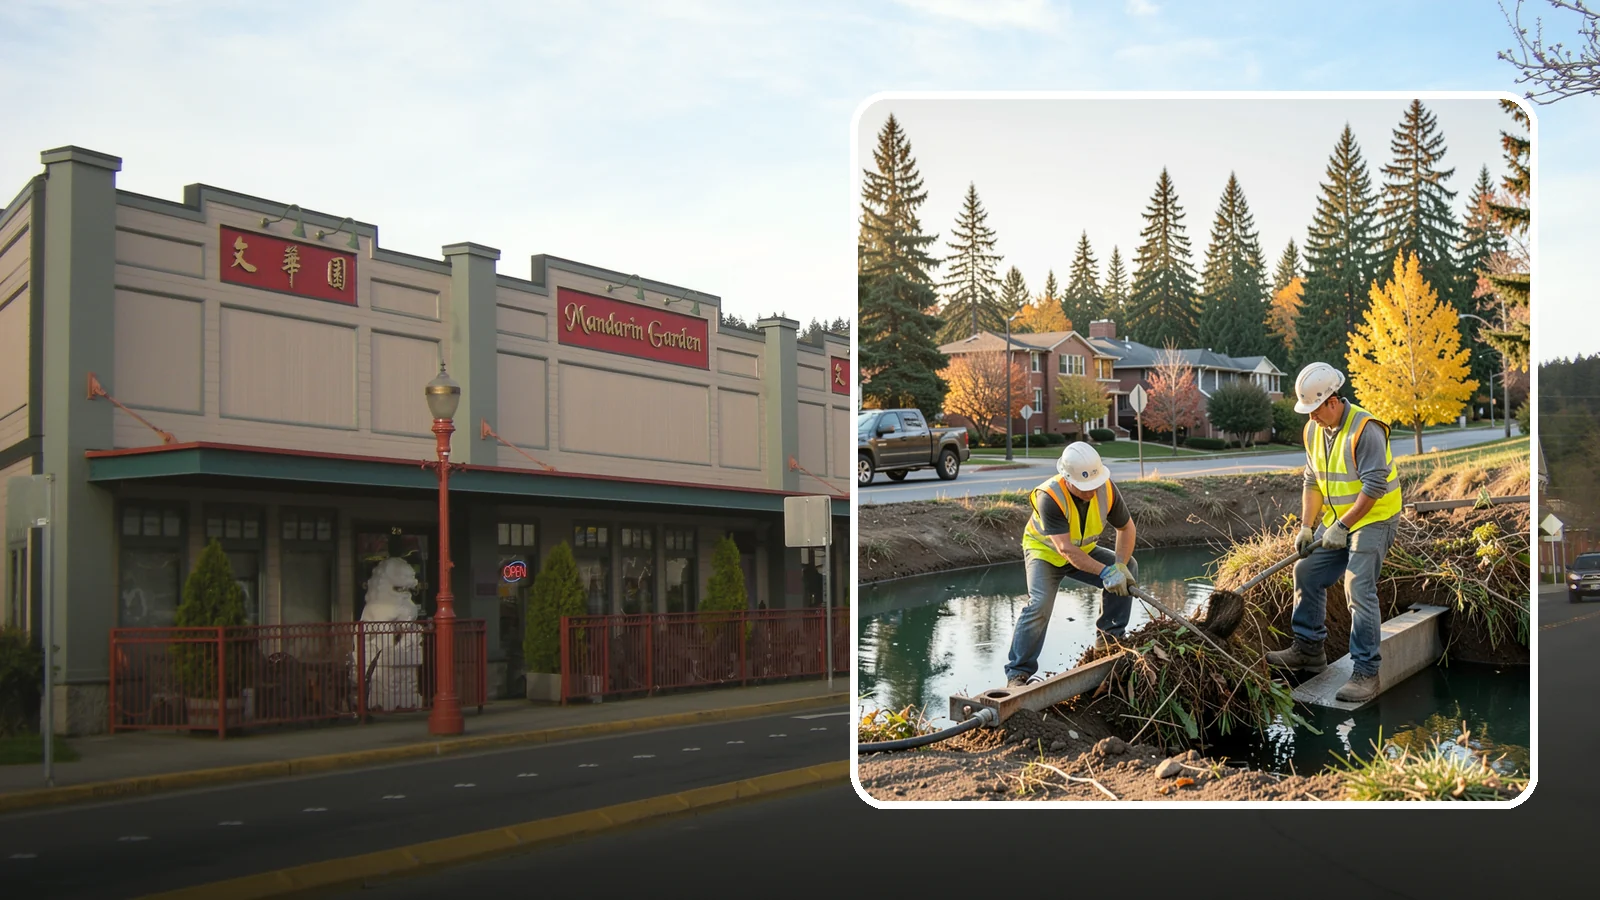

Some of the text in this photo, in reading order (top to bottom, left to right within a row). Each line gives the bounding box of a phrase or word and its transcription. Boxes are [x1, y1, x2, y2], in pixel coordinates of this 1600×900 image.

[231, 236, 346, 291] 文華園
[564, 302, 702, 352] Mandarin Garden
[503, 565, 527, 578] OPEN
